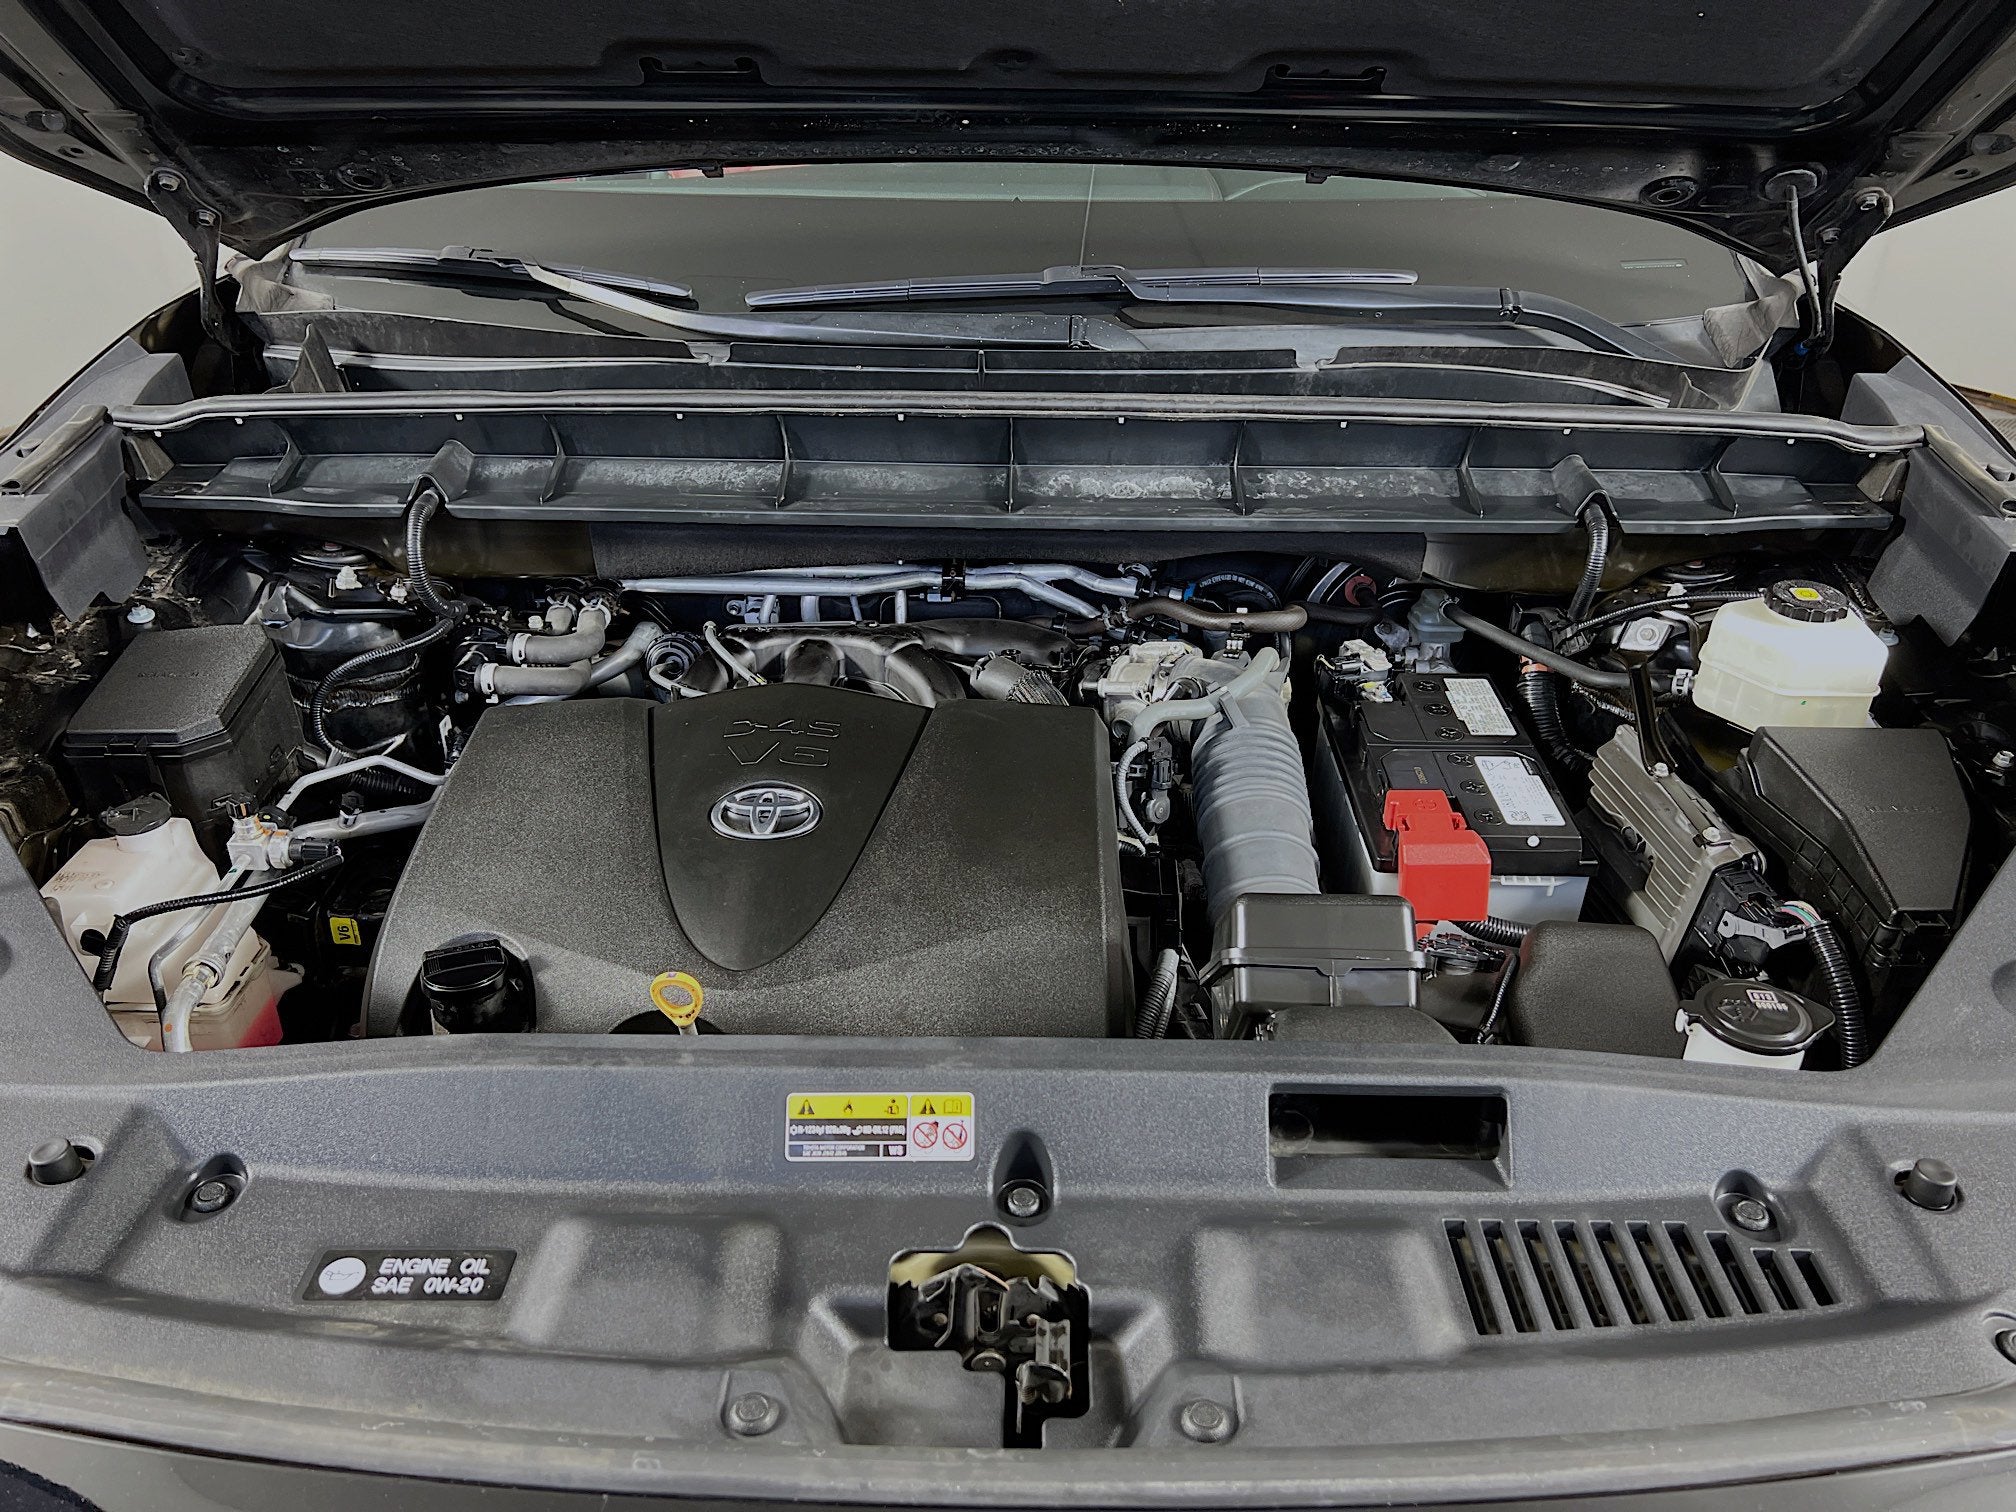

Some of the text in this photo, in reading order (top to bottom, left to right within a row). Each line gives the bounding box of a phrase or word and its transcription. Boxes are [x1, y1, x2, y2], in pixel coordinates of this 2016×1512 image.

[727, 741, 830, 767] V6
[337, 925, 351, 941] V6
[378, 1257, 491, 1275] ENGINE OIL
[371, 1276, 485, 1294] SAE 0W-20
